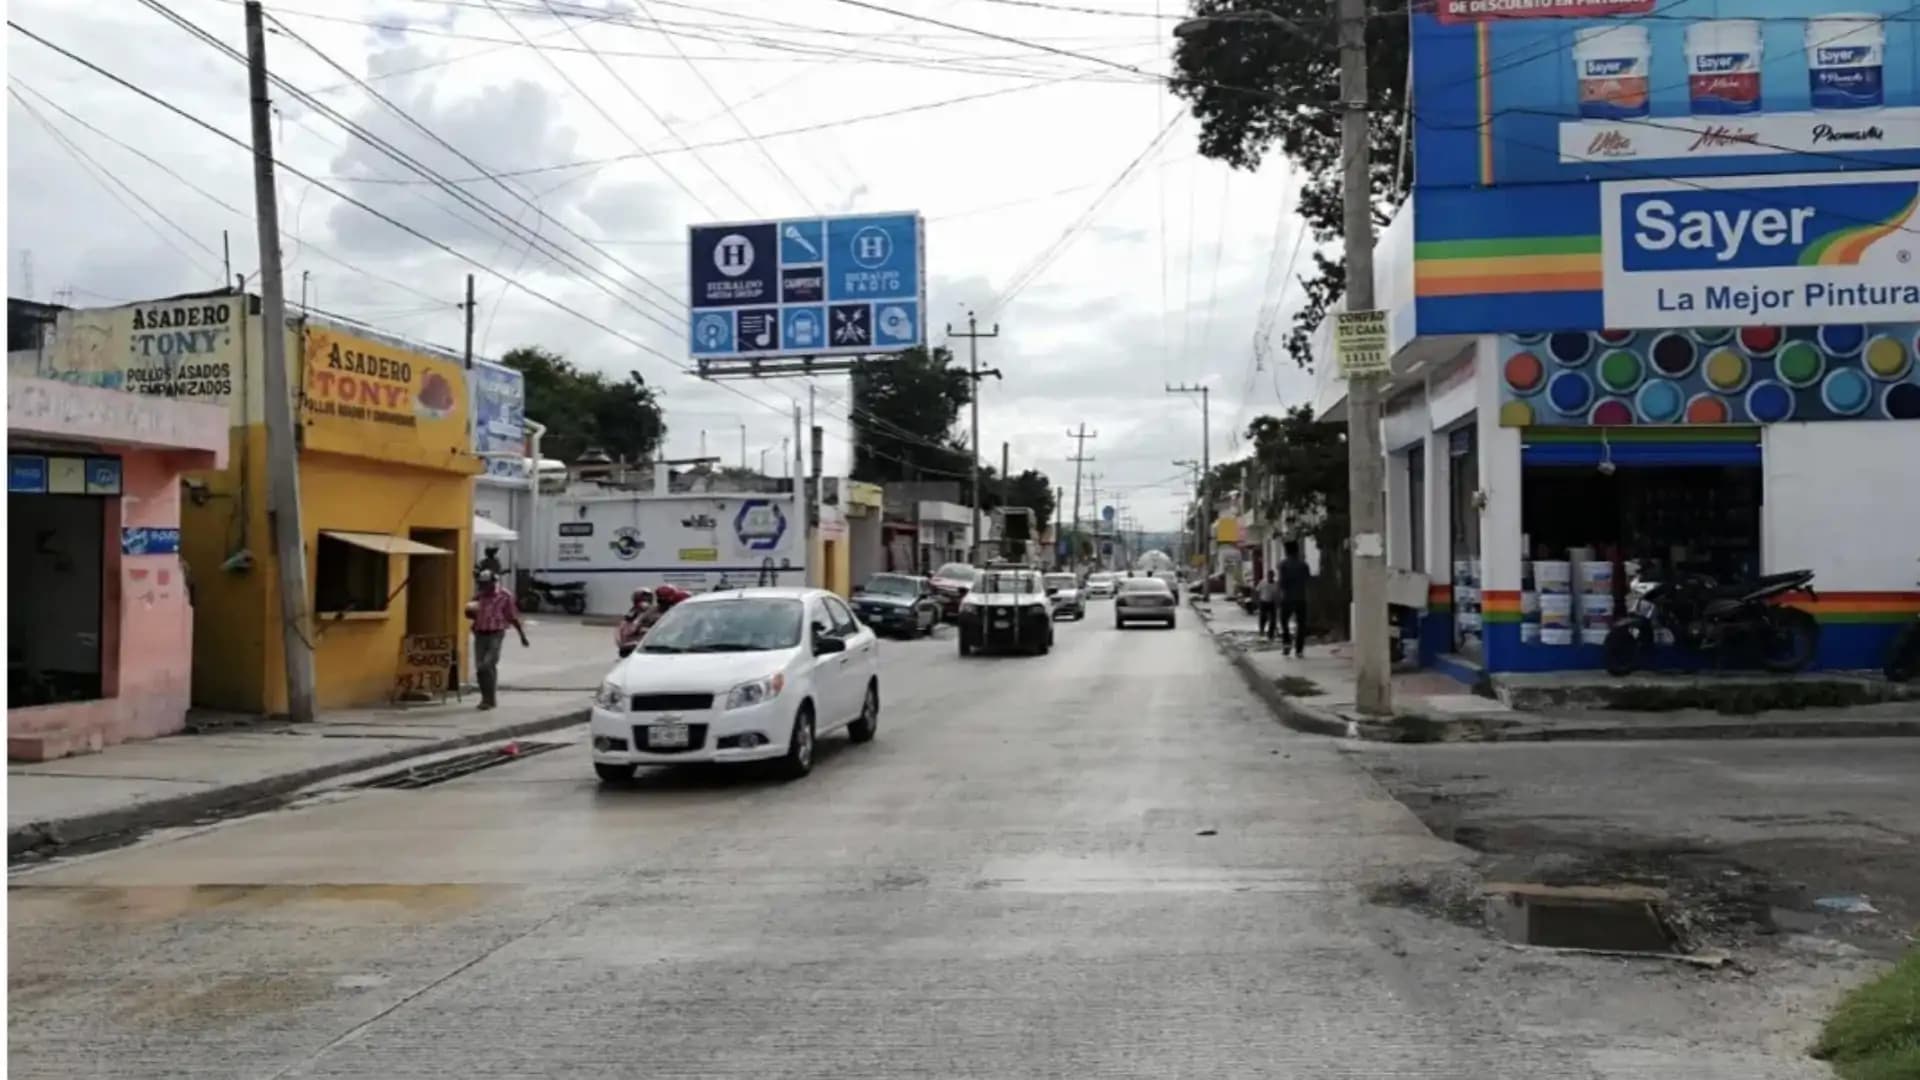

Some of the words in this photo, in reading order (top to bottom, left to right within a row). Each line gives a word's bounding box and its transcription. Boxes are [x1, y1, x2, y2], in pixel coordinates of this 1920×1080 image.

[1635, 199, 1815, 261] Sayer
[1657, 287, 1694, 311] La
[1706, 285, 1795, 315] Mejor
[132, 304, 230, 330] ASADERO
[137, 330, 222, 356] TONY
[178, 363, 230, 380] ASADOS
[328, 341, 411, 384] ASADERO
[316, 370, 403, 409] TONY
